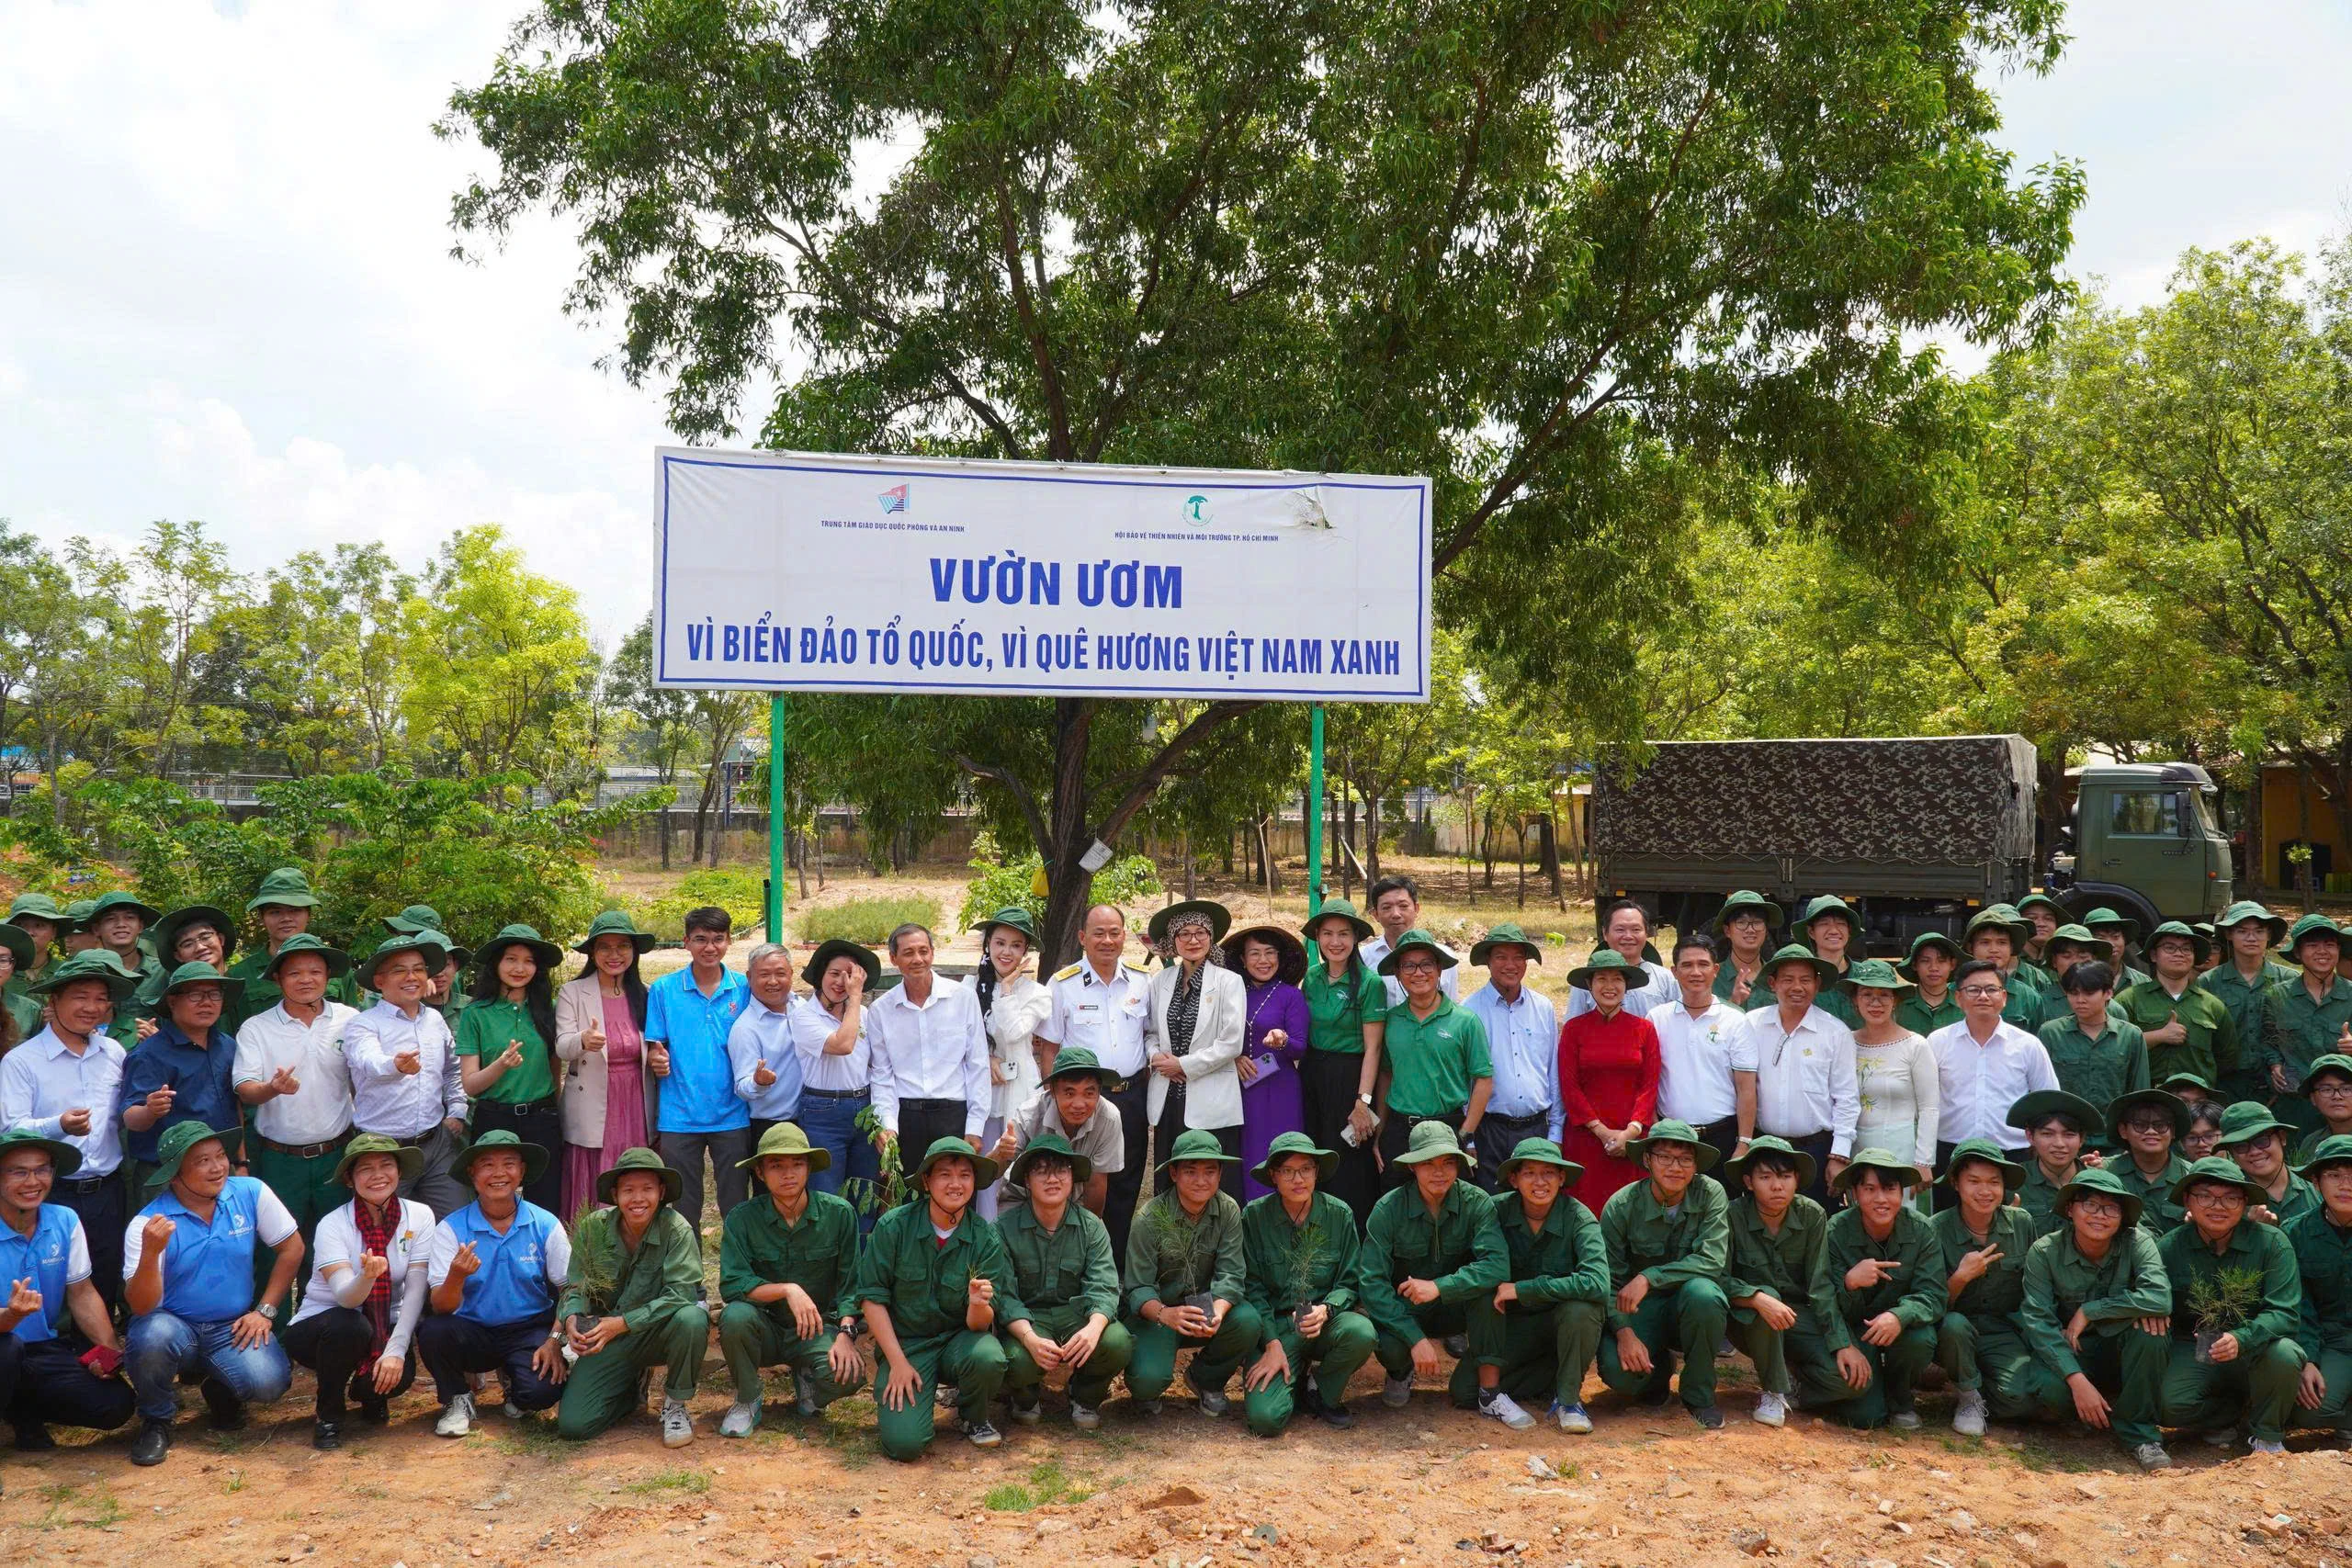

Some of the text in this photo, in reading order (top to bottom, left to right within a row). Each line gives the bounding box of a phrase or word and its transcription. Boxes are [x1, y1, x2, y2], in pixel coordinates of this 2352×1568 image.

[821, 520, 842, 528] TRUNG
[875, 523, 888, 531] DỤC
[1262, 534, 1279, 542] MINH
[930, 550, 1182, 609] VƯỜN ƯƠM
[687, 611, 1399, 680] VÌ BIỂN ĐẢO TỔ QUỐC, VÌ QUÊ HƯƠNG VIỆT NAM XANH
